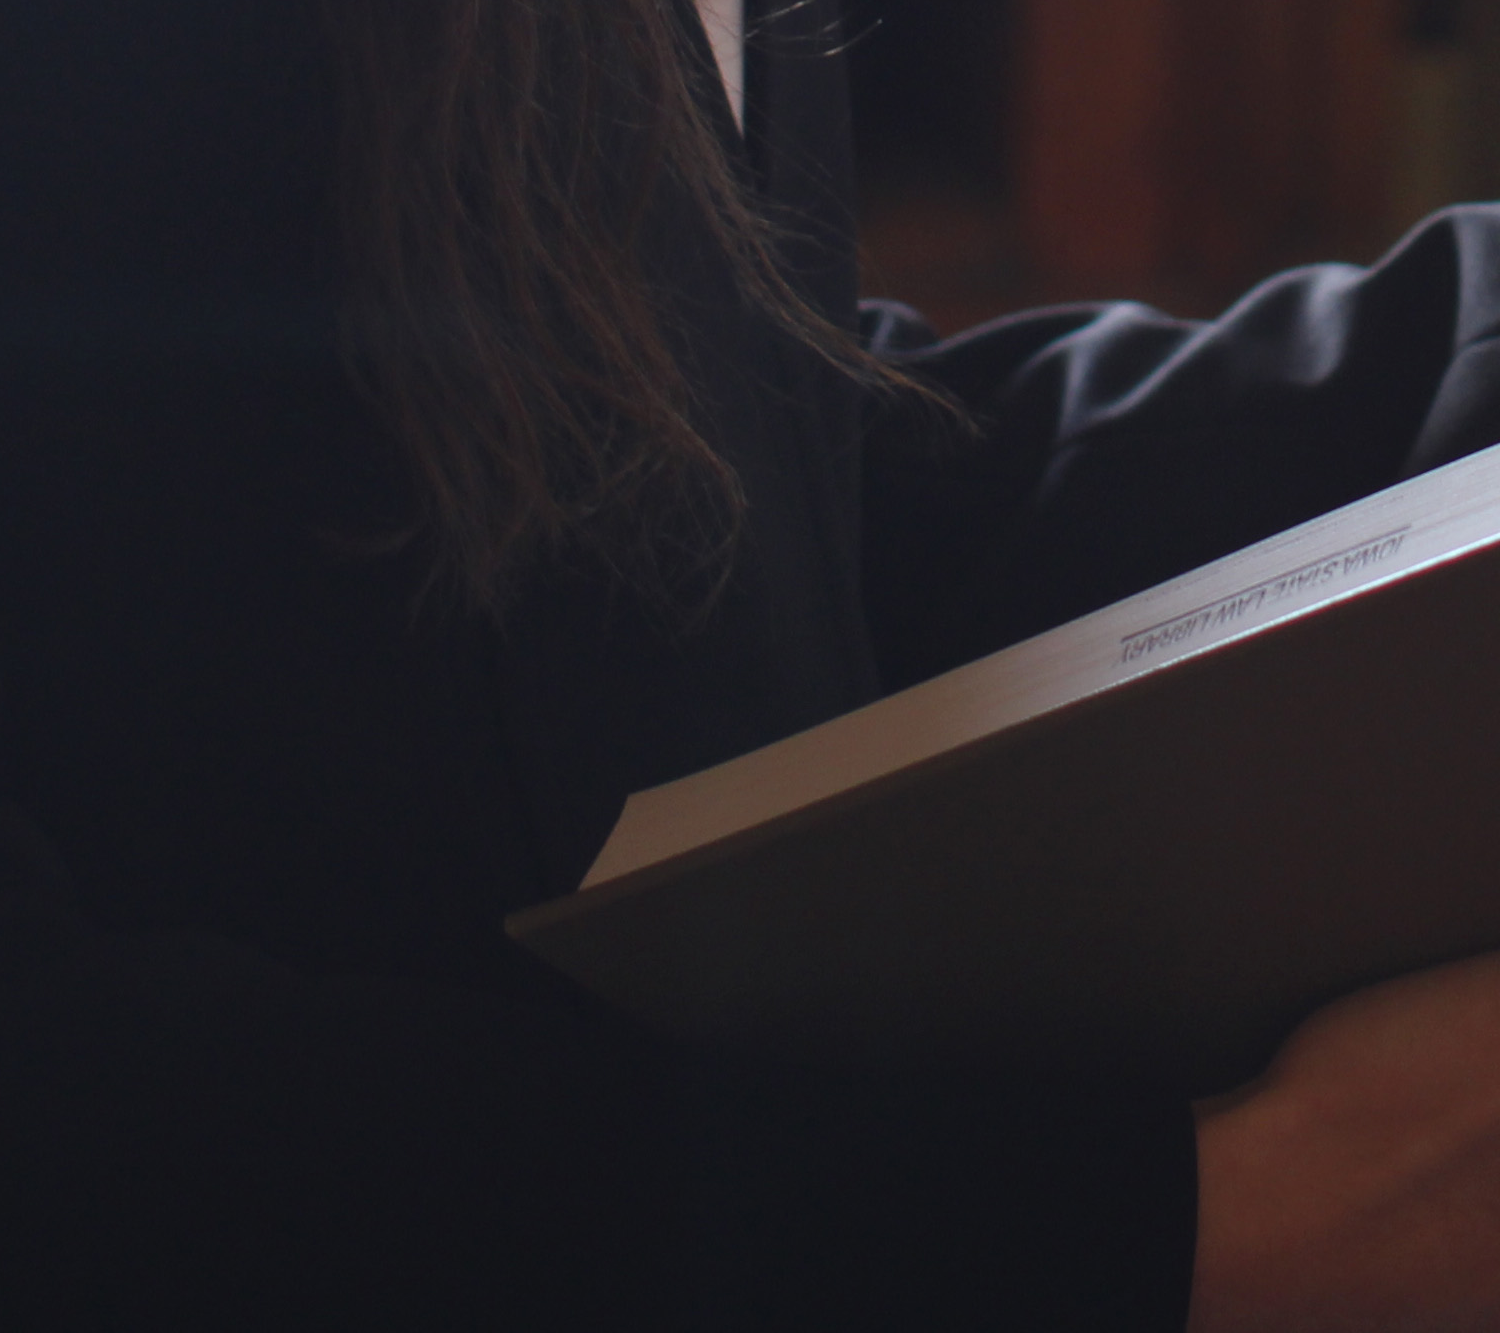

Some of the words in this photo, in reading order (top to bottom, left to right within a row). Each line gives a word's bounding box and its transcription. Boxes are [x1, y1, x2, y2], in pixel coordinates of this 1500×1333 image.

[1343, 533, 1407, 571] IOWA
[1213, 589, 1266, 626] LAW
[1117, 610, 1212, 665] LIBRARY
